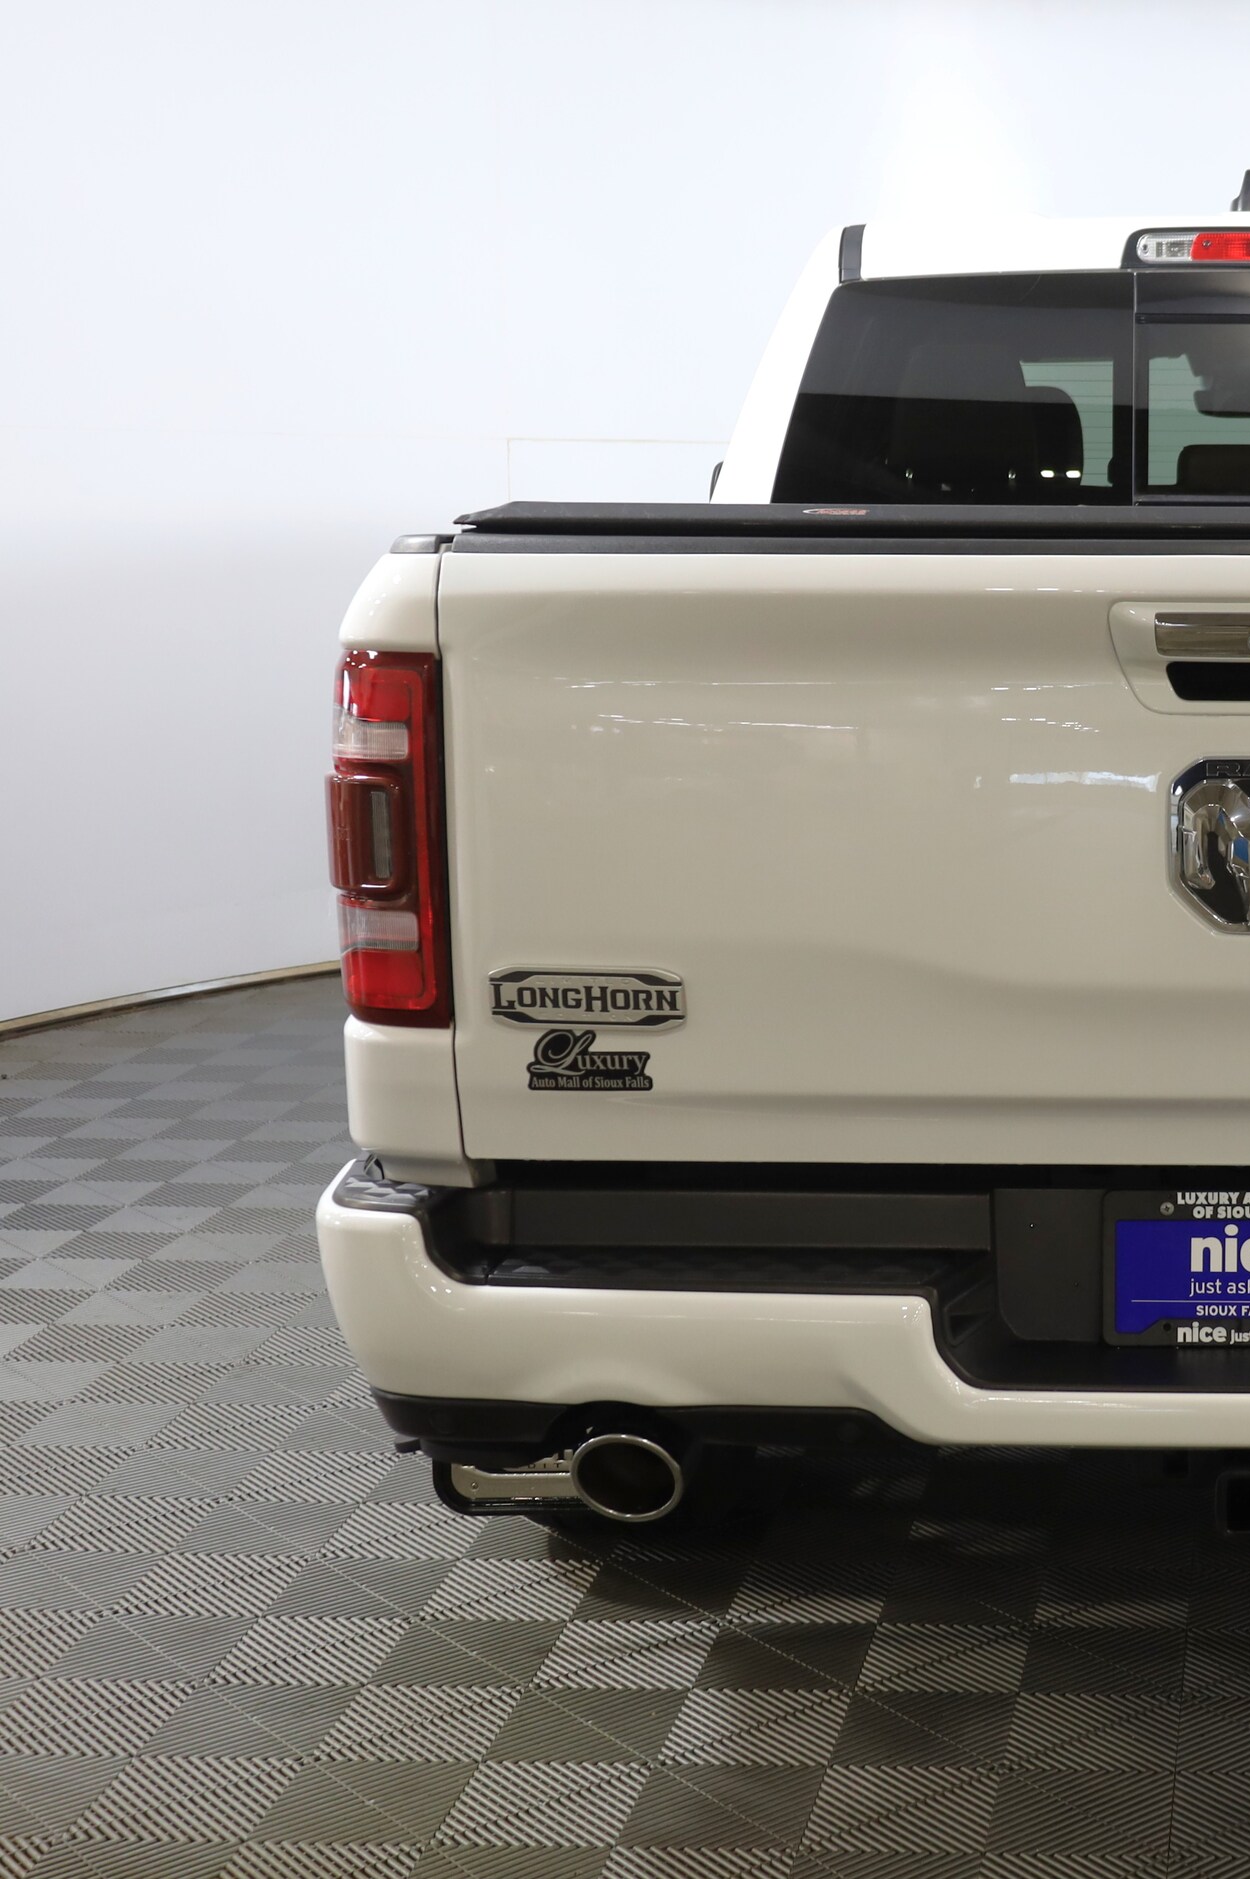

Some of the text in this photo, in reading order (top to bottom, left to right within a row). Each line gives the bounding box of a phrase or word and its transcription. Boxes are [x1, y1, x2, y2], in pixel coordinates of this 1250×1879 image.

[529, 1031, 647, 1076] Luxury
[531, 1076, 650, 1089] Auto Mall of Sioux Falls
[1177, 1191, 1240, 1205] LUXURY
[1192, 1206, 1214, 1219] OF
[1189, 1278, 1222, 1297] just
[1196, 1305, 1237, 1317] SIOUX
[1177, 1321, 1228, 1343] nice
